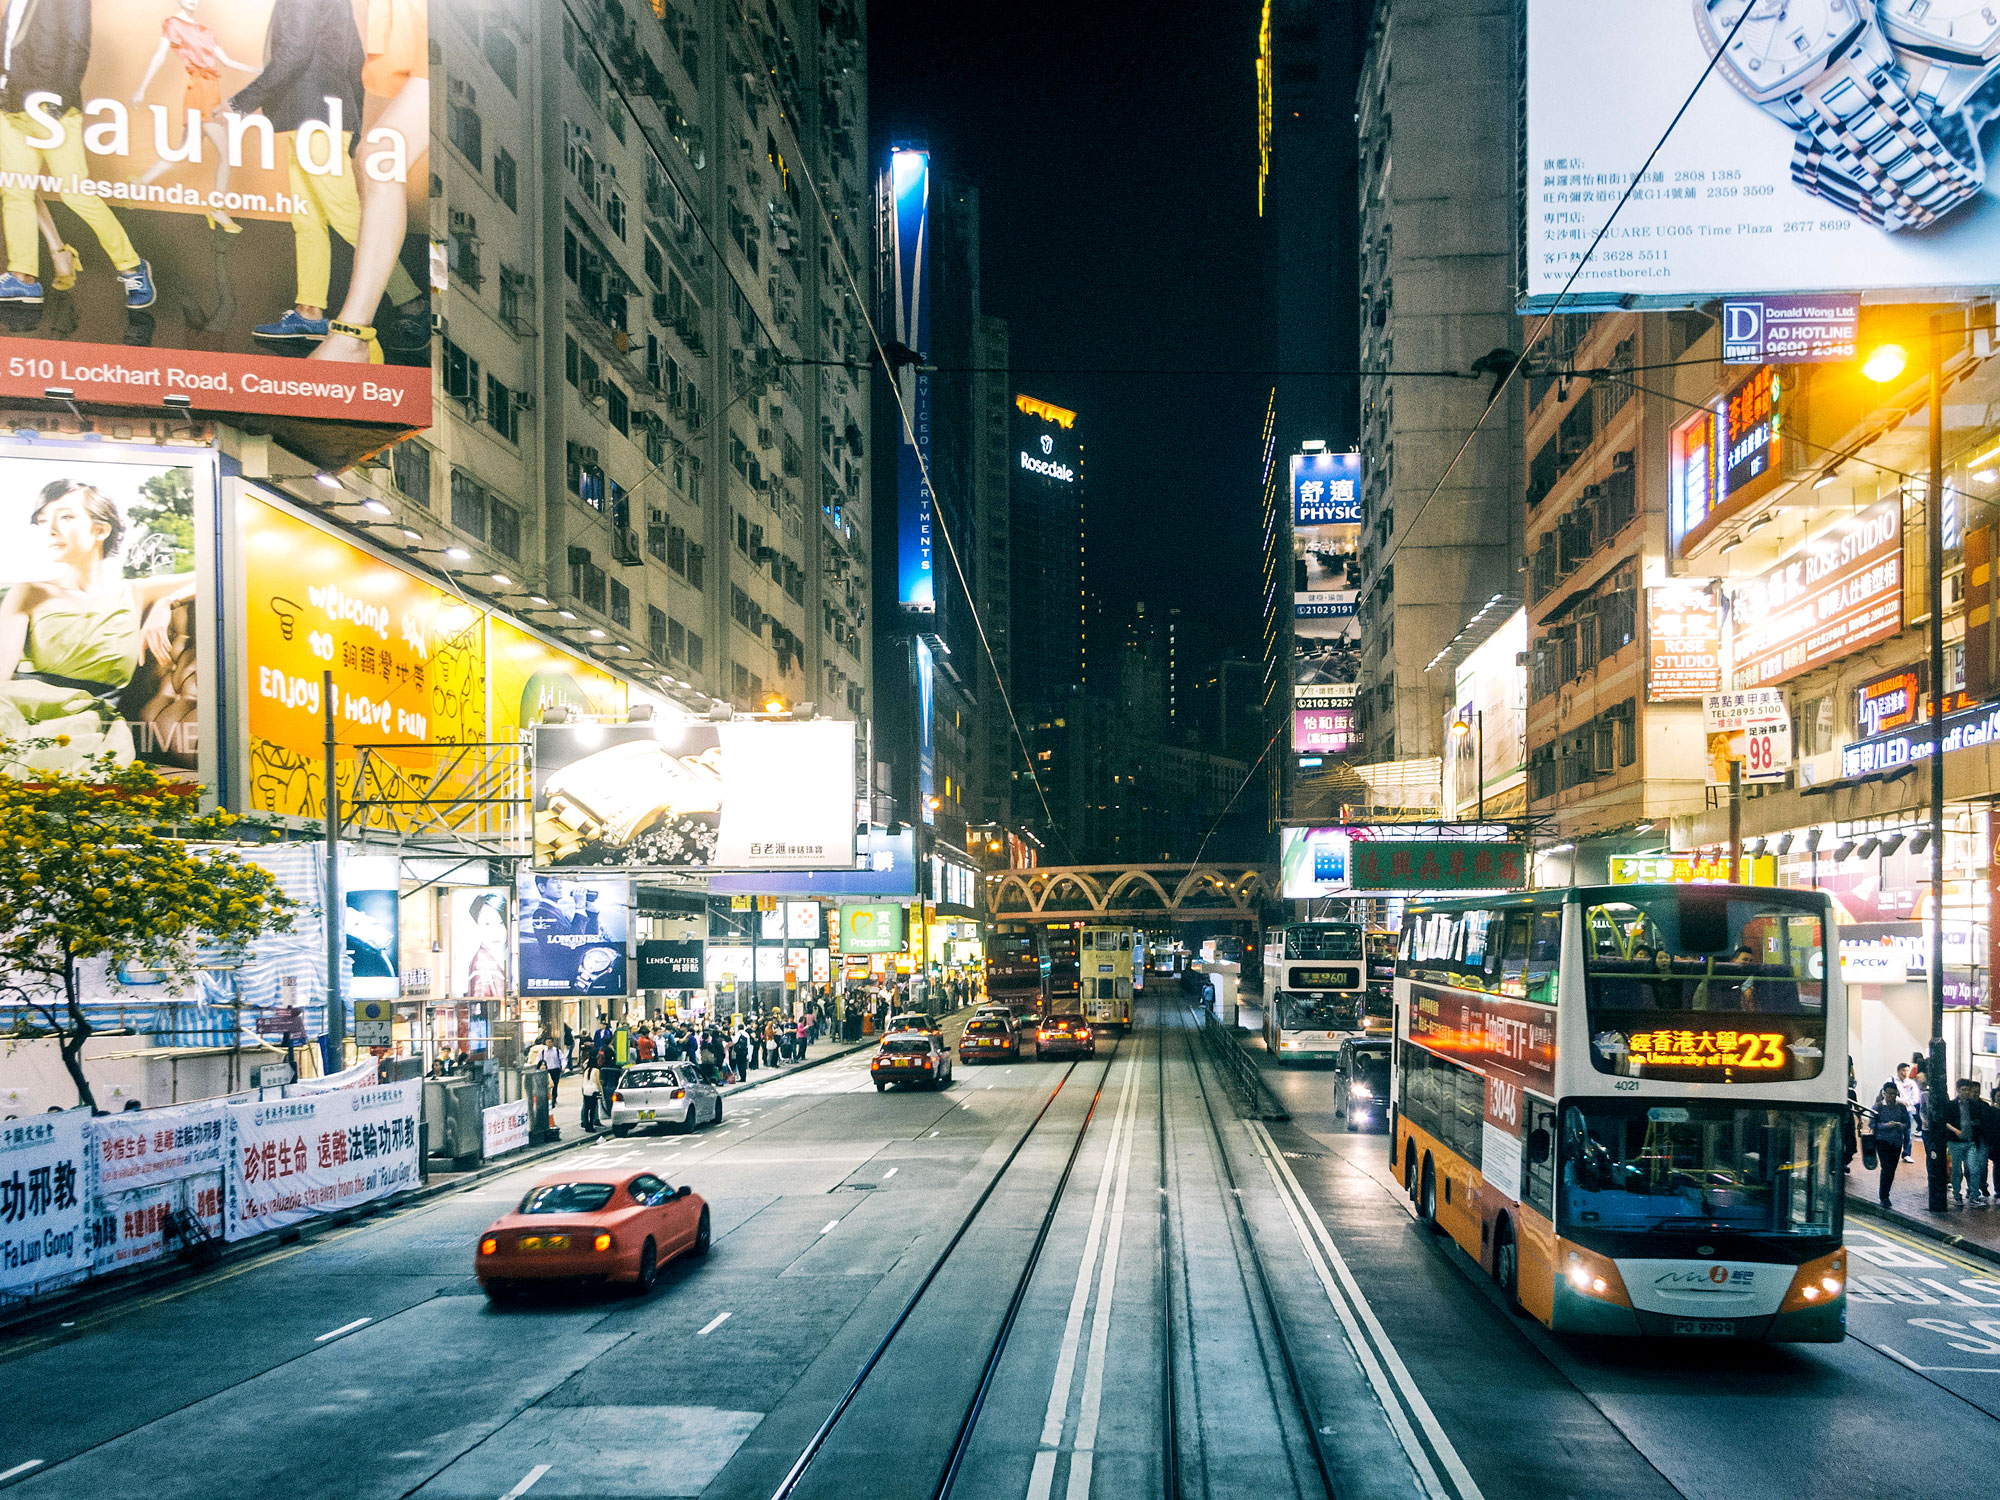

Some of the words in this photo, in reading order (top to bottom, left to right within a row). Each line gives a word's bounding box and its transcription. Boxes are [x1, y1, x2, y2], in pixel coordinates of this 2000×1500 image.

[23, 91, 409, 184] saunda
[1674, 171, 1704, 182] 2808
[1711, 170, 1742, 181] 1385
[1707, 187, 1738, 199] 2359
[1743, 185, 1775, 197] 3509
[1656, 225, 1693, 236] UG05
[1698, 224, 1732, 236] Time
[1737, 223, 1773, 234] Plaza
[1783, 221, 1814, 233] 2677
[1819, 219, 1851, 231] 8699
[1602, 250, 1634, 261] 3628
[1638, 250, 1668, 260] 5511
[1543, 266, 1671, 279] wwwernestborel.ch
[1765, 308, 1803, 318] Donald
[1803, 308, 1834, 319] Wong
[1836, 307, 1855, 317] Ltd.
[1768, 327, 1789, 340] AD
[1791, 326, 1853, 340] HOTLINE
[8, 357, 54, 379] 510
[60, 361, 160, 388] Lockhart
[166, 369, 235, 395] Road,
[240, 374, 356, 404] Causeway
[362, 382, 405, 407] Bay
[918, 351, 930, 446] SRVICED
[1020, 451, 1074, 482] Rosedale
[1299, 479, 1355, 503] 舒適
[1805, 542, 1840, 585] ROSE
[1840, 509, 1896, 565] STUDIO
[308, 583, 389, 641] welcome
[1305, 605, 1329, 614] 2102
[1330, 605, 1353, 614] 9191
[308, 629, 334, 661] to
[1664, 639, 1706, 653] ROSE
[1654, 654, 1715, 669] STUDIO
[1305, 698, 1330, 708] 2102
[1709, 691, 1784, 709] 亮點美甲美容
[1757, 705, 1781, 714] 5100
[1942, 726, 1963, 753] off
[1749, 735, 1772, 770] 98
[546, 934, 602, 944] LONGINES
[1852, 958, 1890, 967] PCCW
[1943, 984, 1958, 999] ony
[1629, 1030, 1739, 1053] 經香港大學
[1737, 1033, 1785, 1068] 23
[1646, 1052, 1707, 1067] University
[1707, 1053, 1721, 1066] of
[1614, 1081, 1640, 1091] 4021
[1493, 1077, 1517, 1127] 3046
[243, 1135, 308, 1185] 珍惜生命
[317, 1114, 416, 1168] 遠離法輪功邪教
[0, 1159, 78, 1224] 功邪教
